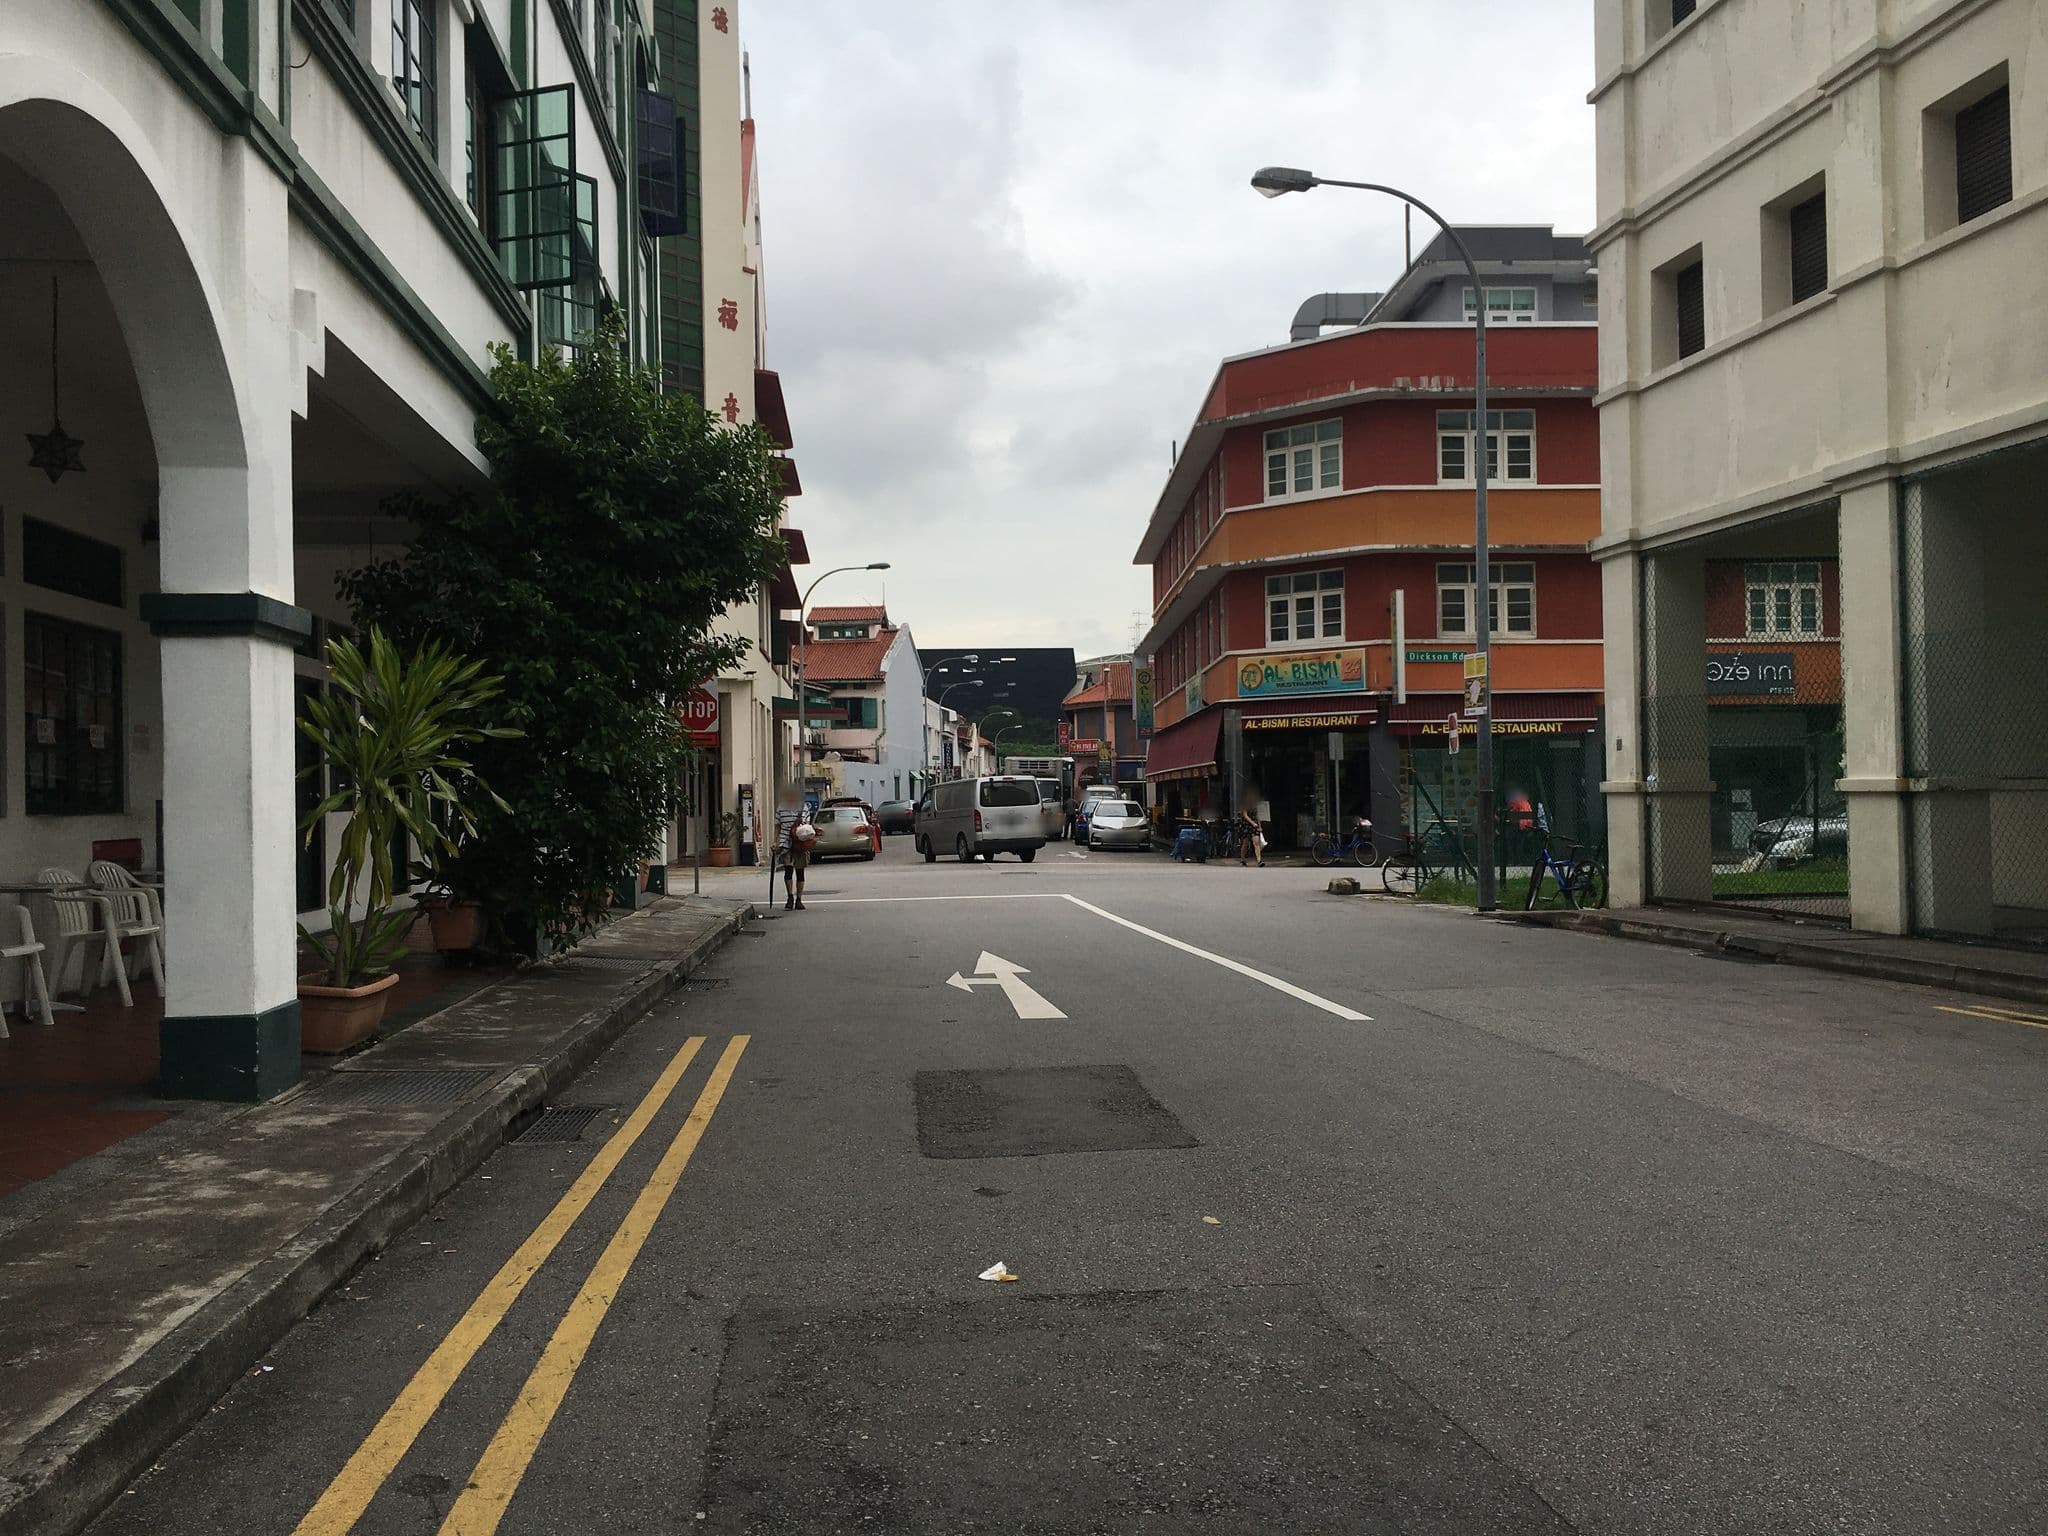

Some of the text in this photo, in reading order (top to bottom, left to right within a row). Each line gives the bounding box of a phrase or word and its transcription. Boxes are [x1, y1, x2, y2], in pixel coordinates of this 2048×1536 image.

[1409, 652, 1464, 660] Dickson Rd
[1245, 715, 1359, 729] AL-BISMI RESTAURANT
[1422, 723, 1563, 734] AL-BSMI ESTAURANT
